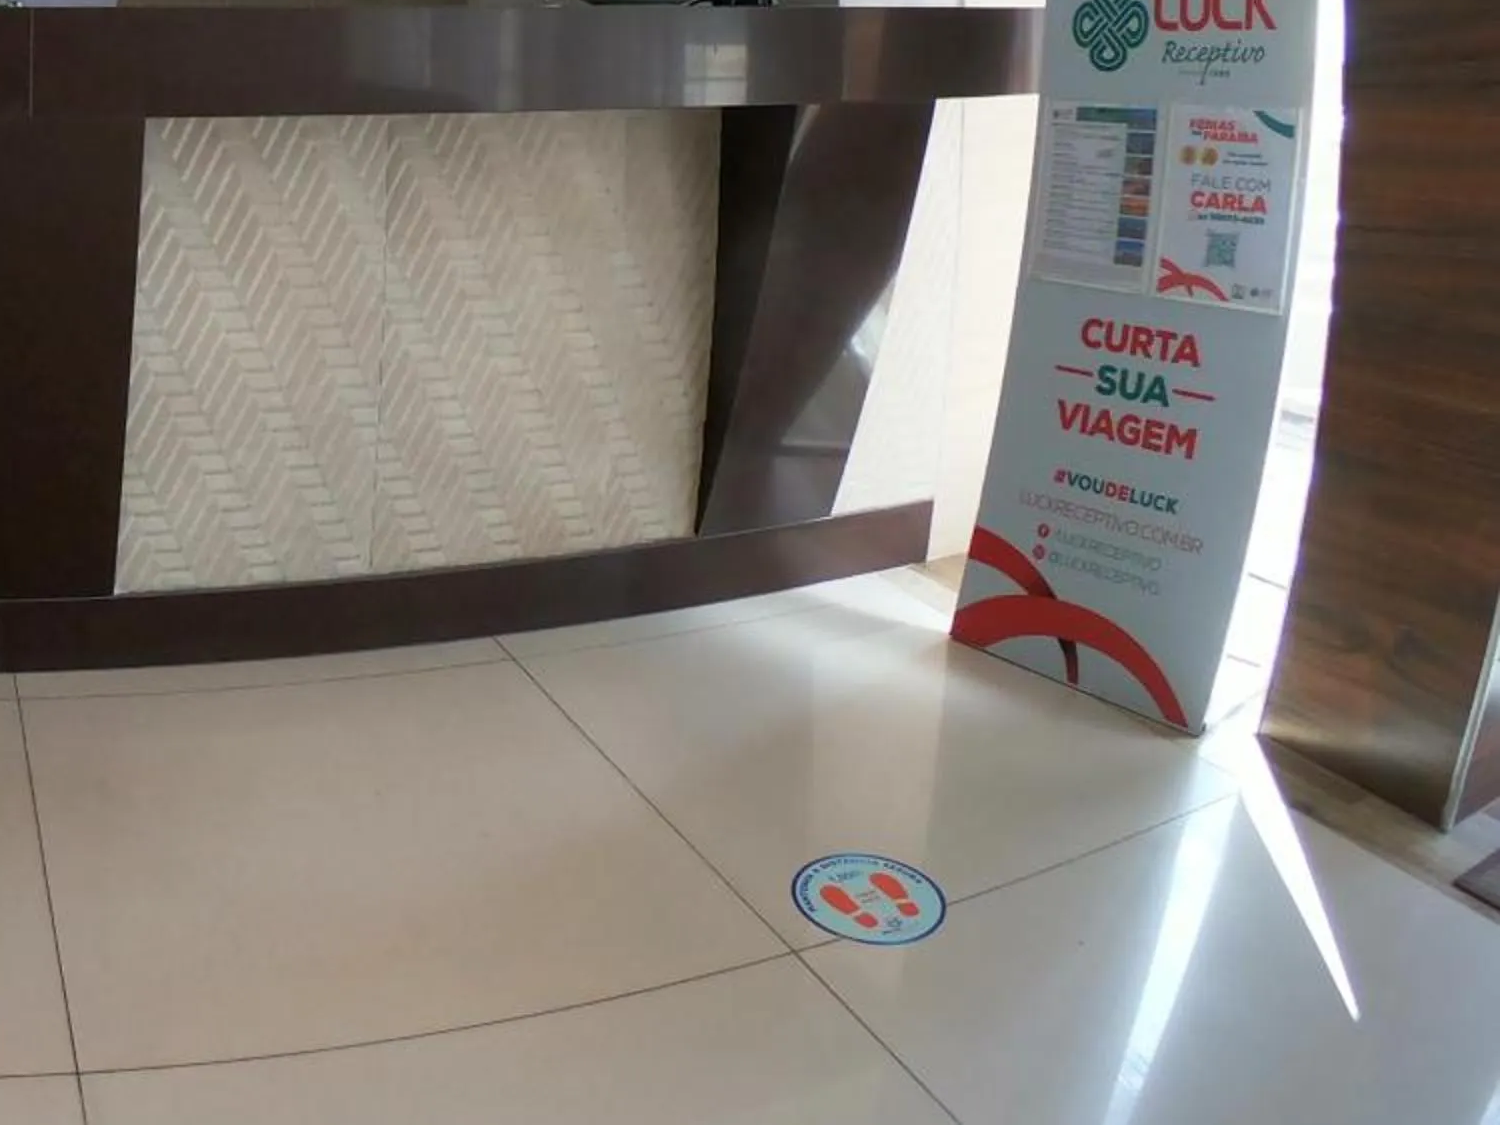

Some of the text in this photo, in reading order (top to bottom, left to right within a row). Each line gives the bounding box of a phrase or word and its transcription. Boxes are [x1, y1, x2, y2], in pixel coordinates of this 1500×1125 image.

[1161, 40, 1266, 85] Receptivo
[1190, 175, 1272, 193] FALE COM
[1190, 191, 1268, 215] CARLA
[1081, 317, 1201, 367] CURTA
[1095, 364, 1169, 408] SUA
[1057, 399, 1198, 460] VIAGEM
[1053, 468, 1179, 516] #VOUDELUCK
